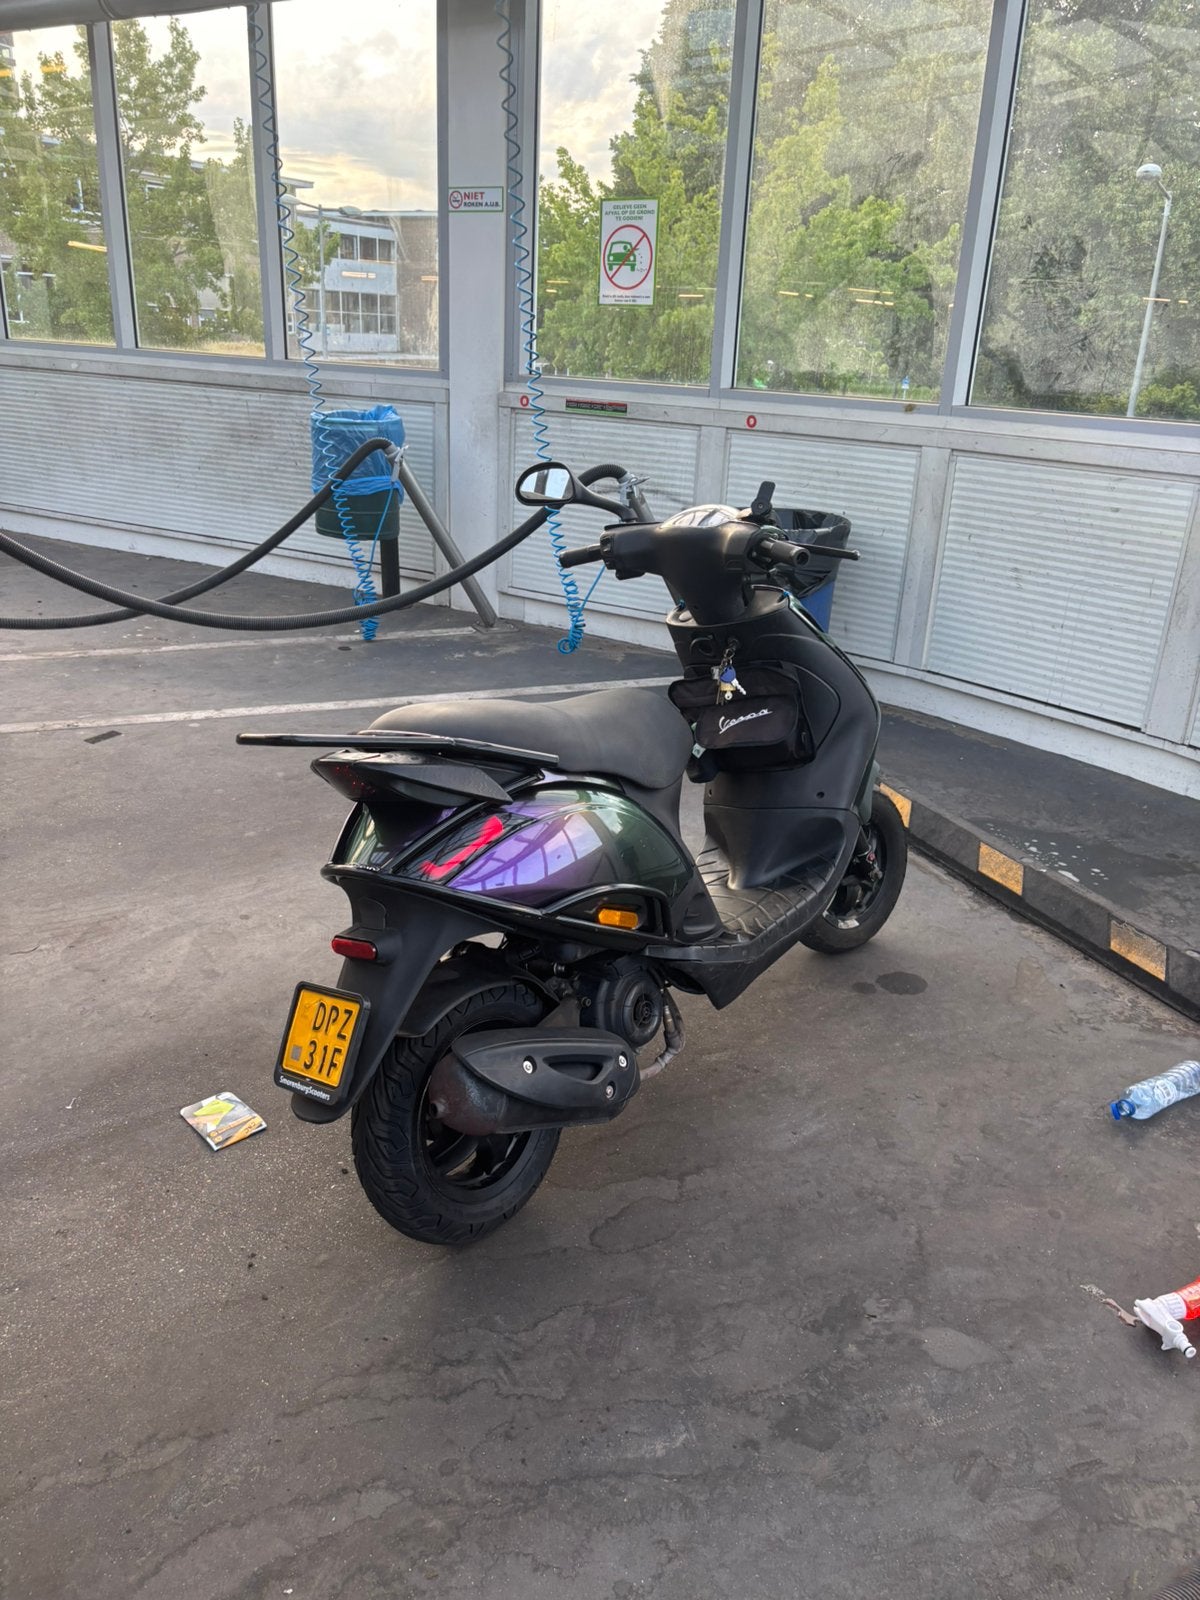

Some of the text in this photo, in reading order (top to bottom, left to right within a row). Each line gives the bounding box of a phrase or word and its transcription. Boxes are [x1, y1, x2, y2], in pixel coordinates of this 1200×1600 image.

[463, 191, 484, 200] NIET
[718, 708, 773, 734] Vespa
[312, 1001, 354, 1040] DPZ
[303, 1039, 342, 1078] 31F
